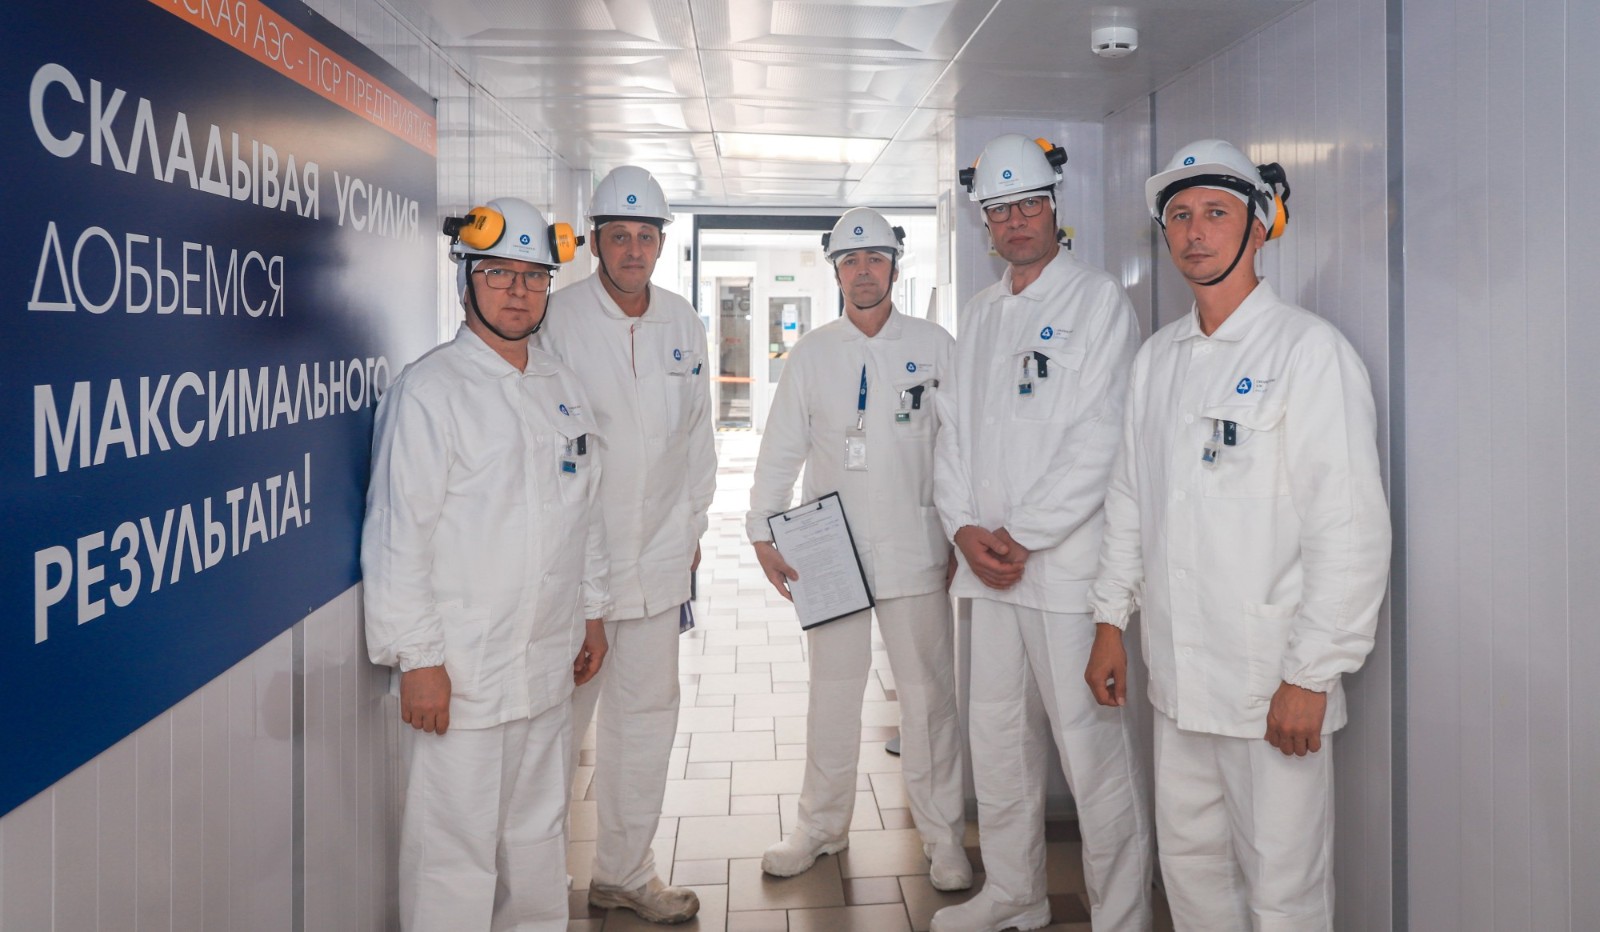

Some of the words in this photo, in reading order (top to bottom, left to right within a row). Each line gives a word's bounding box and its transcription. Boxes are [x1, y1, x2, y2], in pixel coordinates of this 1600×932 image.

[29, 63, 319, 220] СКЛАДЫВАЯ
[253, 14, 294, 70] АЭС
[308, 47, 341, 95] ПСР
[345, 70, 433, 150] ПРЕДПРИЯТИЕ
[28, 221, 284, 318] ДОБЬЕМСЯ
[34, 355, 391, 478] МАКСИМАЛЬНОГО
[34, 453, 311, 645] РЕЗУЛЬТАТА!
